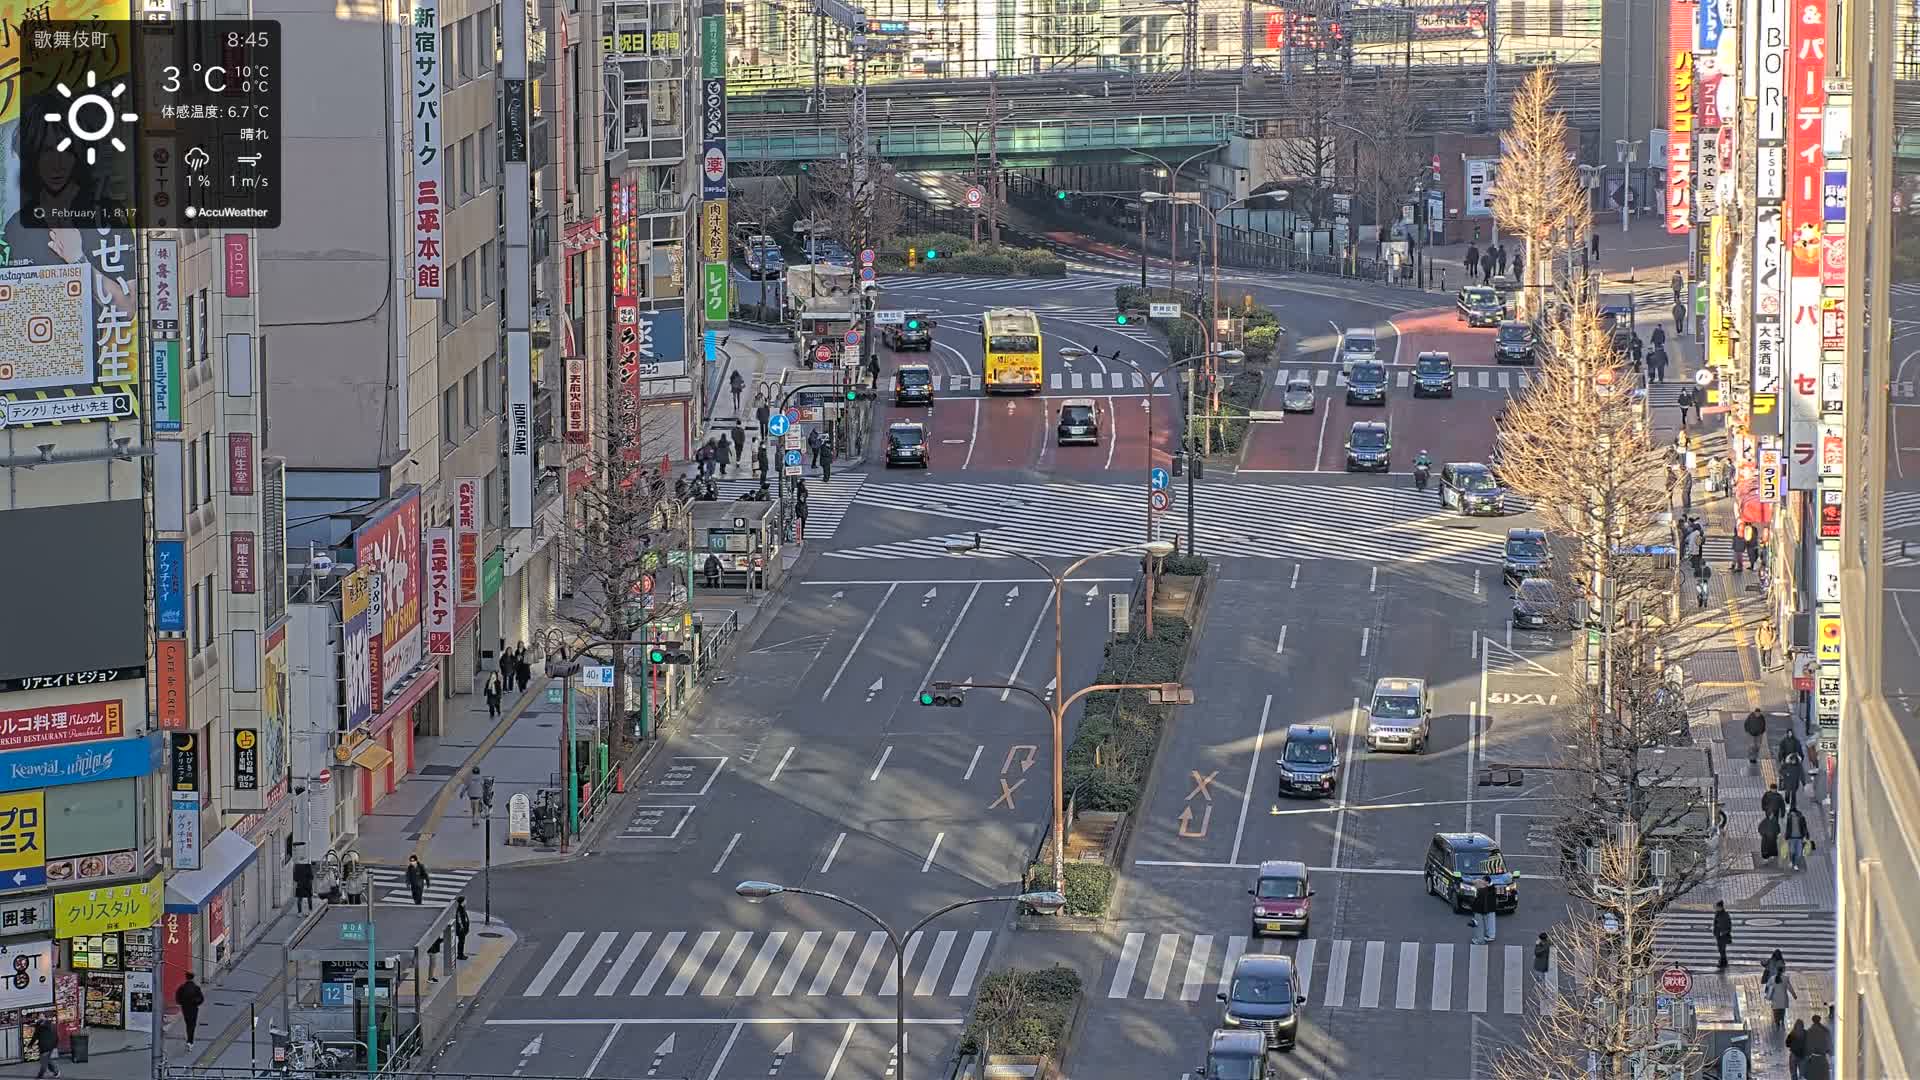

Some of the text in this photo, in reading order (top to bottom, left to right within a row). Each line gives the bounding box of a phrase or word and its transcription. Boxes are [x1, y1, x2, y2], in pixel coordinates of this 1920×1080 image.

[620, 34, 645, 51] 祝日
[651, 32, 680, 50] 夜間
[415, 7, 438, 166] 新宿サンパーク
[1705, 84, 1716, 116] アコム
[1798, 6, 1824, 200] & パーティー
[706, 157, 724, 173] 薬
[417, 180, 440, 288] 三平本館
[709, 203, 723, 259] 肉汁水餃子
[709, 272, 723, 310] レイク
[156, 320, 174, 329] 3F
[619, 327, 637, 385] ラーメン
[155, 350, 167, 411] FamilyMart
[12, 401, 109, 417] テンクリ たいせい先生
[513, 403, 526, 456] HOMEGAME
[234, 446, 249, 484] 龍生堂
[459, 483, 471, 527] GAME
[712, 537, 725, 548] 10
[236, 543, 249, 579] 龍生堂
[159, 552, 169, 602] ゲウチャイ
[431, 539, 448, 625] 三平ストア
[431, 632, 442, 641] B1
[439, 644, 450, 652] B2
[22, 670, 118, 690] リアエイド ビジョン
[68, 713, 104, 727] パムッカレ
[108, 707, 118, 733] 5F
[163, 718, 180, 727] B2
[23, 731, 68, 743] RESTAURANT
[1, 807, 38, 831] プロ
[0, 835, 38, 854] ミス
[2, 907, 37, 928] 囲碁
[68, 899, 140, 922] クリスタル
[325, 987, 341, 1000] 12
[1664, 977, 1685, 987] 消火栓
